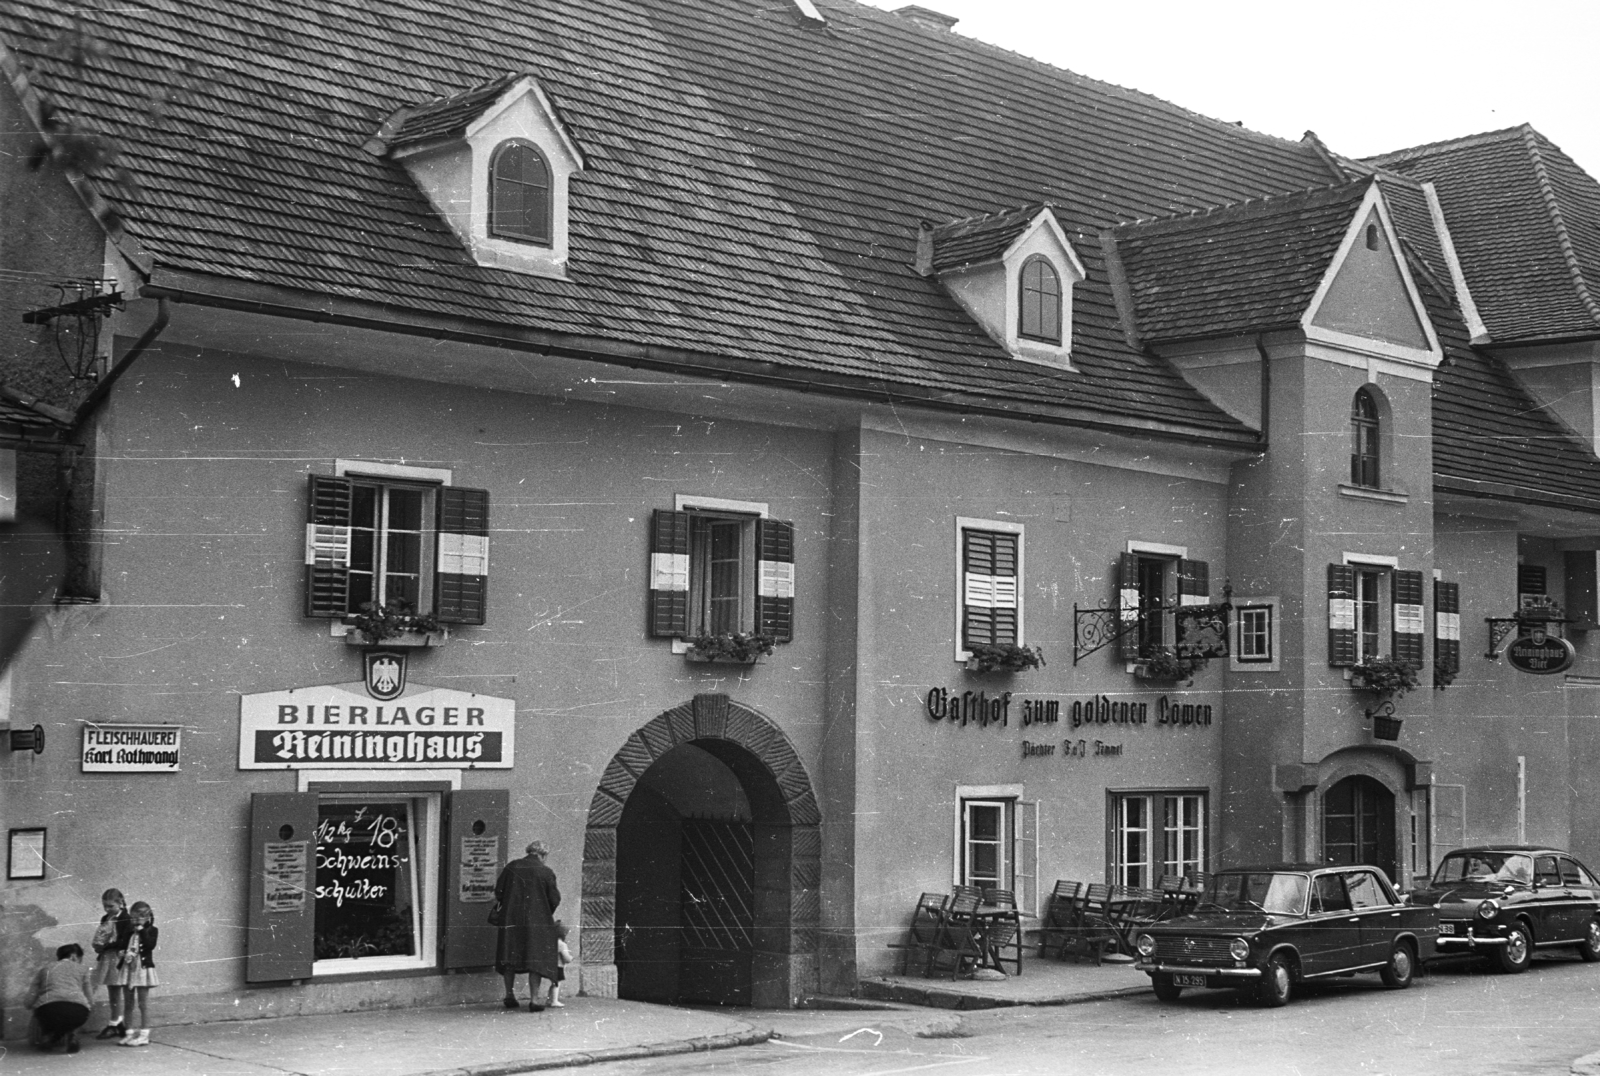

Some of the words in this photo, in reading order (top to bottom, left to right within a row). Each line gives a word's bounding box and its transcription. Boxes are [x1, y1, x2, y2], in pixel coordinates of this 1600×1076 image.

[1513, 646, 1564, 659] Reininghaus
[1529, 658, 1548, 669] Bier
[277, 704, 485, 726] BIERLAGER
[1023, 699, 1059, 726] zum
[1073, 694, 1147, 728] goldenen
[88, 730, 177, 746] FLEISCHHAUEREI
[272, 730, 485, 762] Reininghaus
[84, 747, 113, 764] Karl
[116, 748, 178, 768] Rothwangl
[337, 821, 353, 843] kg
[316, 847, 409, 877] Schweins-
[315, 878, 387, 908] schulter
